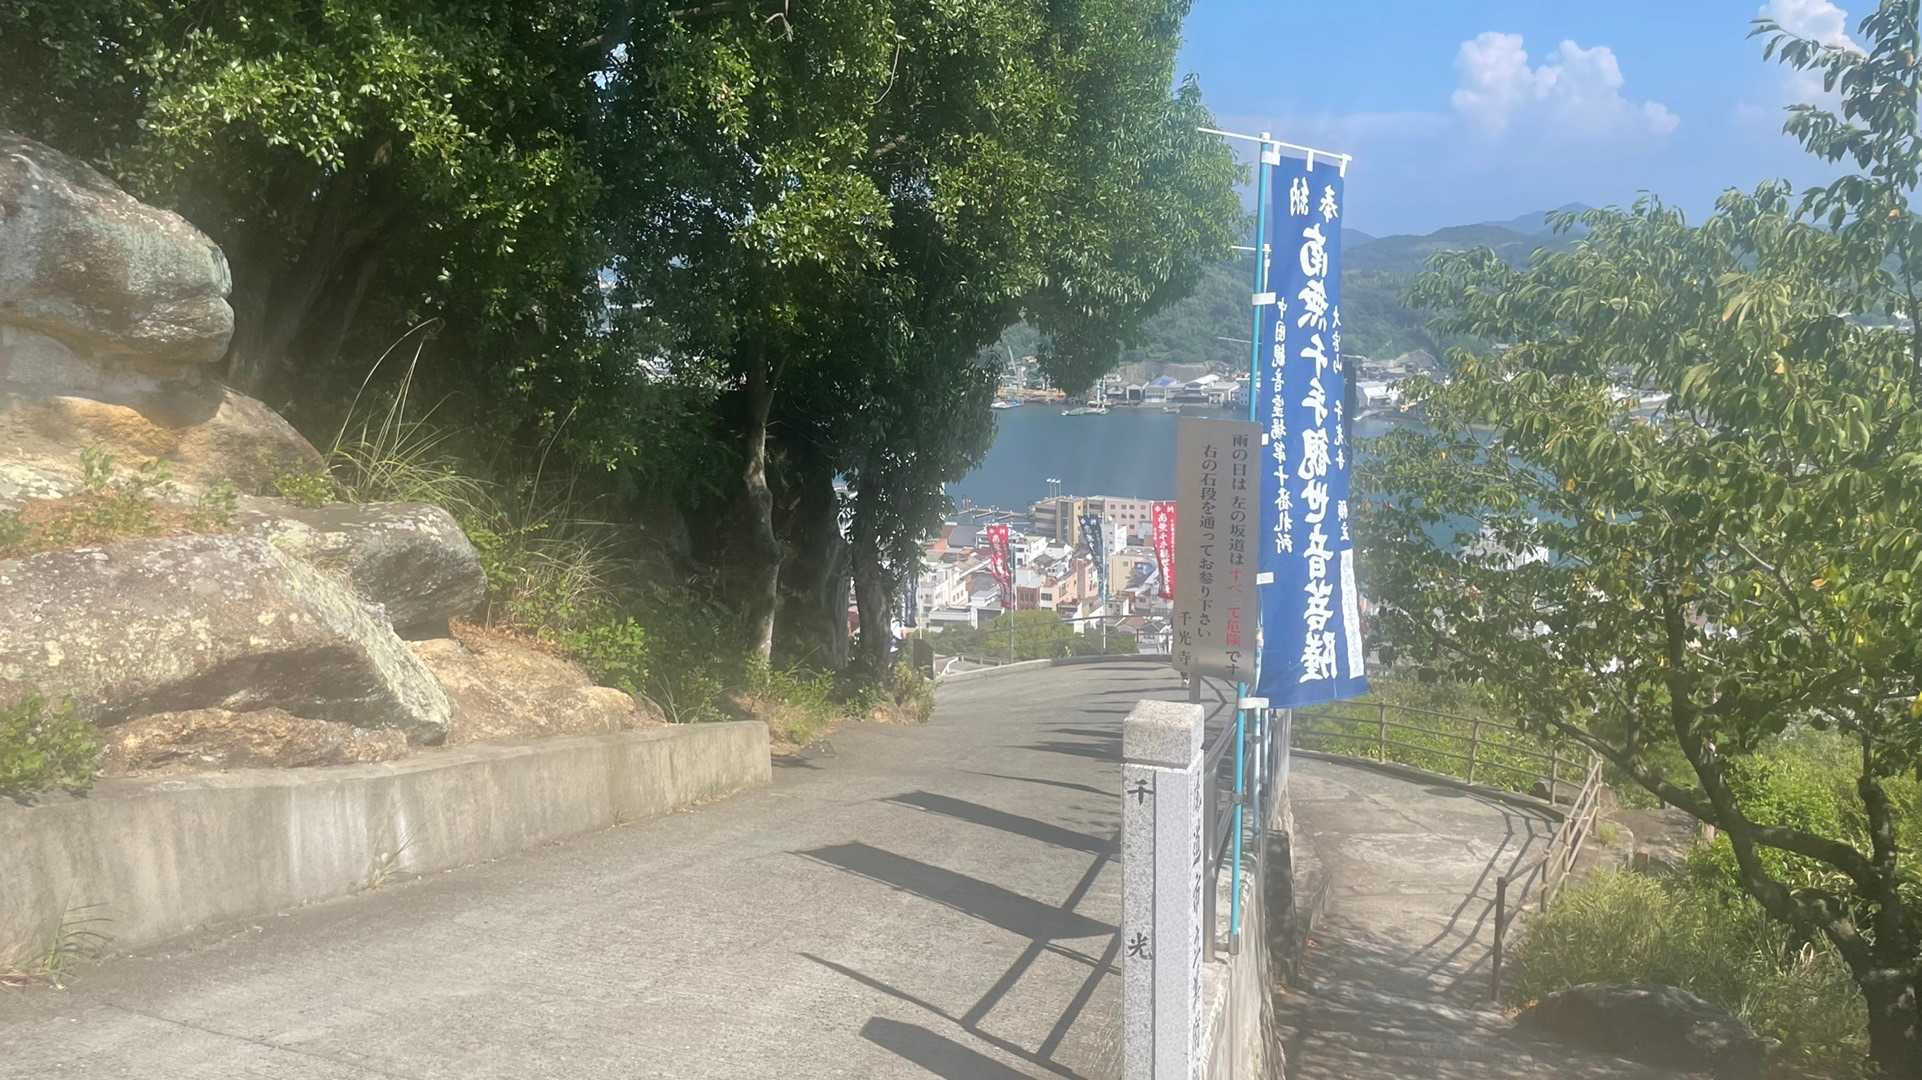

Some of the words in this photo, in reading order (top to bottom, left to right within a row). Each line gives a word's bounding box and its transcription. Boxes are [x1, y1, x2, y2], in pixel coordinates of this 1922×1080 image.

[1199, 444, 1217, 637] 右の石段を通ってお参り下さい
